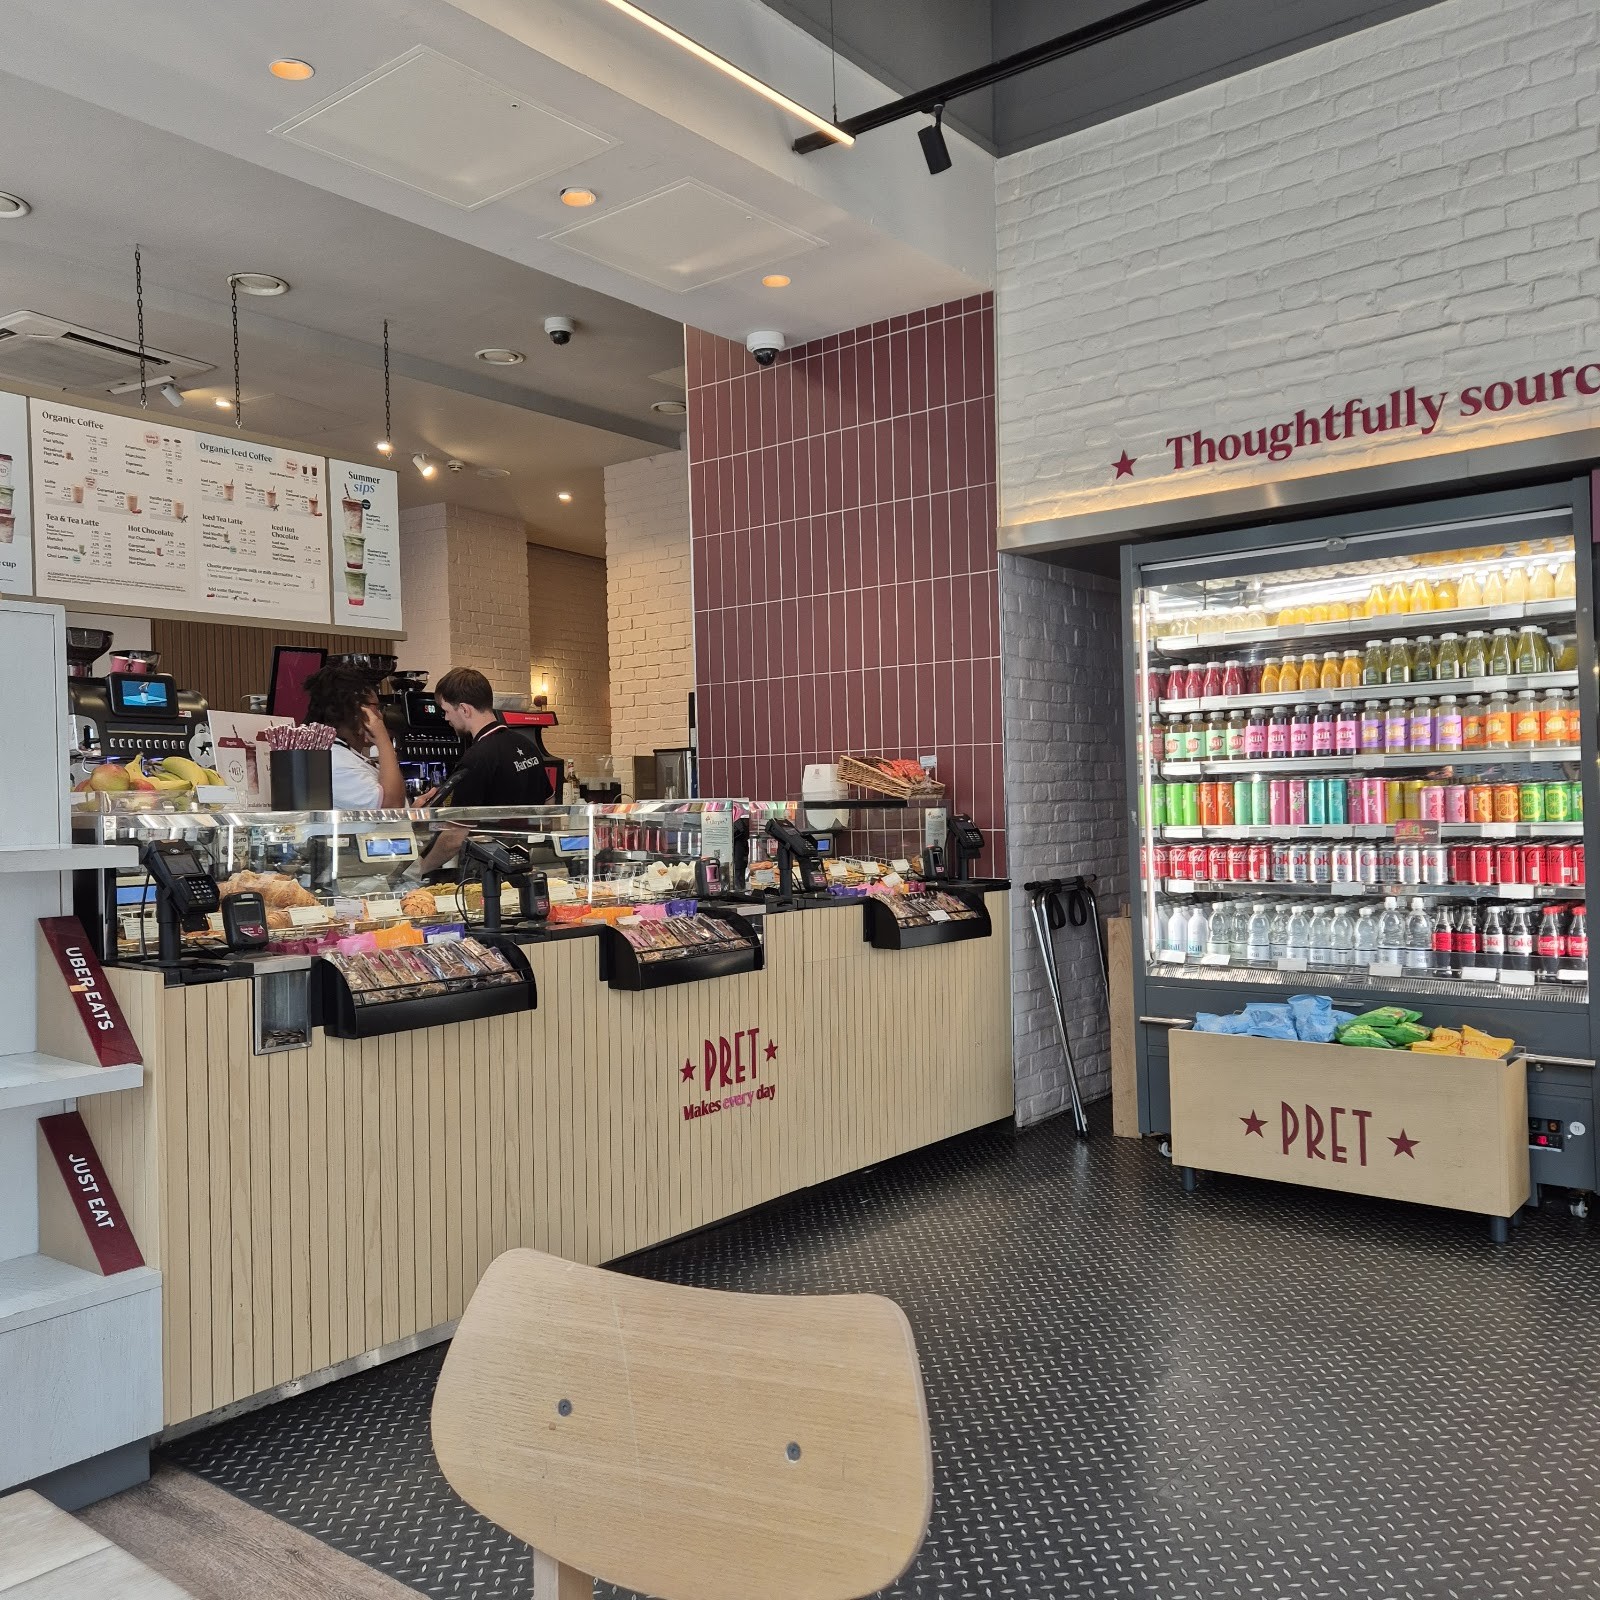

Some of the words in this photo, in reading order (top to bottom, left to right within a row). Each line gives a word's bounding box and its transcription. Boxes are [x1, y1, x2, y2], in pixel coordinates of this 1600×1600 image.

[42, 411, 76, 425] Organic
[77, 418, 104, 430] Coffee
[1166, 385, 1448, 472] Thoughtfully
[200, 442, 231, 454] Organic
[232, 448, 248, 458] Iced
[249, 452, 273, 463] Coffee
[348, 471, 381, 485] Summer
[354, 482, 376, 496] sips
[46, 513, 59, 522] Tea
[67, 516, 80, 525] Tea
[81, 519, 100, 527] Latte
[228, 518, 244, 526] Latte
[272, 524, 284, 532] Iced
[128, 525, 141, 533] Hot
[142, 527, 175, 538] Chocolate
[272, 532, 300, 541] Chocolate
[2, 561, 17, 569] cup
[513, 756, 540, 772] Barista
[66, 947, 96, 988] UBER
[85, 991, 115, 1031] EATS
[705, 1028, 760, 1092] PRET
[684, 1100, 722, 1121] Makes
[723, 1091, 755, 1110] every
[756, 1084, 776, 1101] day
[1281, 1101, 1372, 1167] PRET
[69, 1153, 100, 1193] JUST
[88, 1197, 115, 1230] EAT
